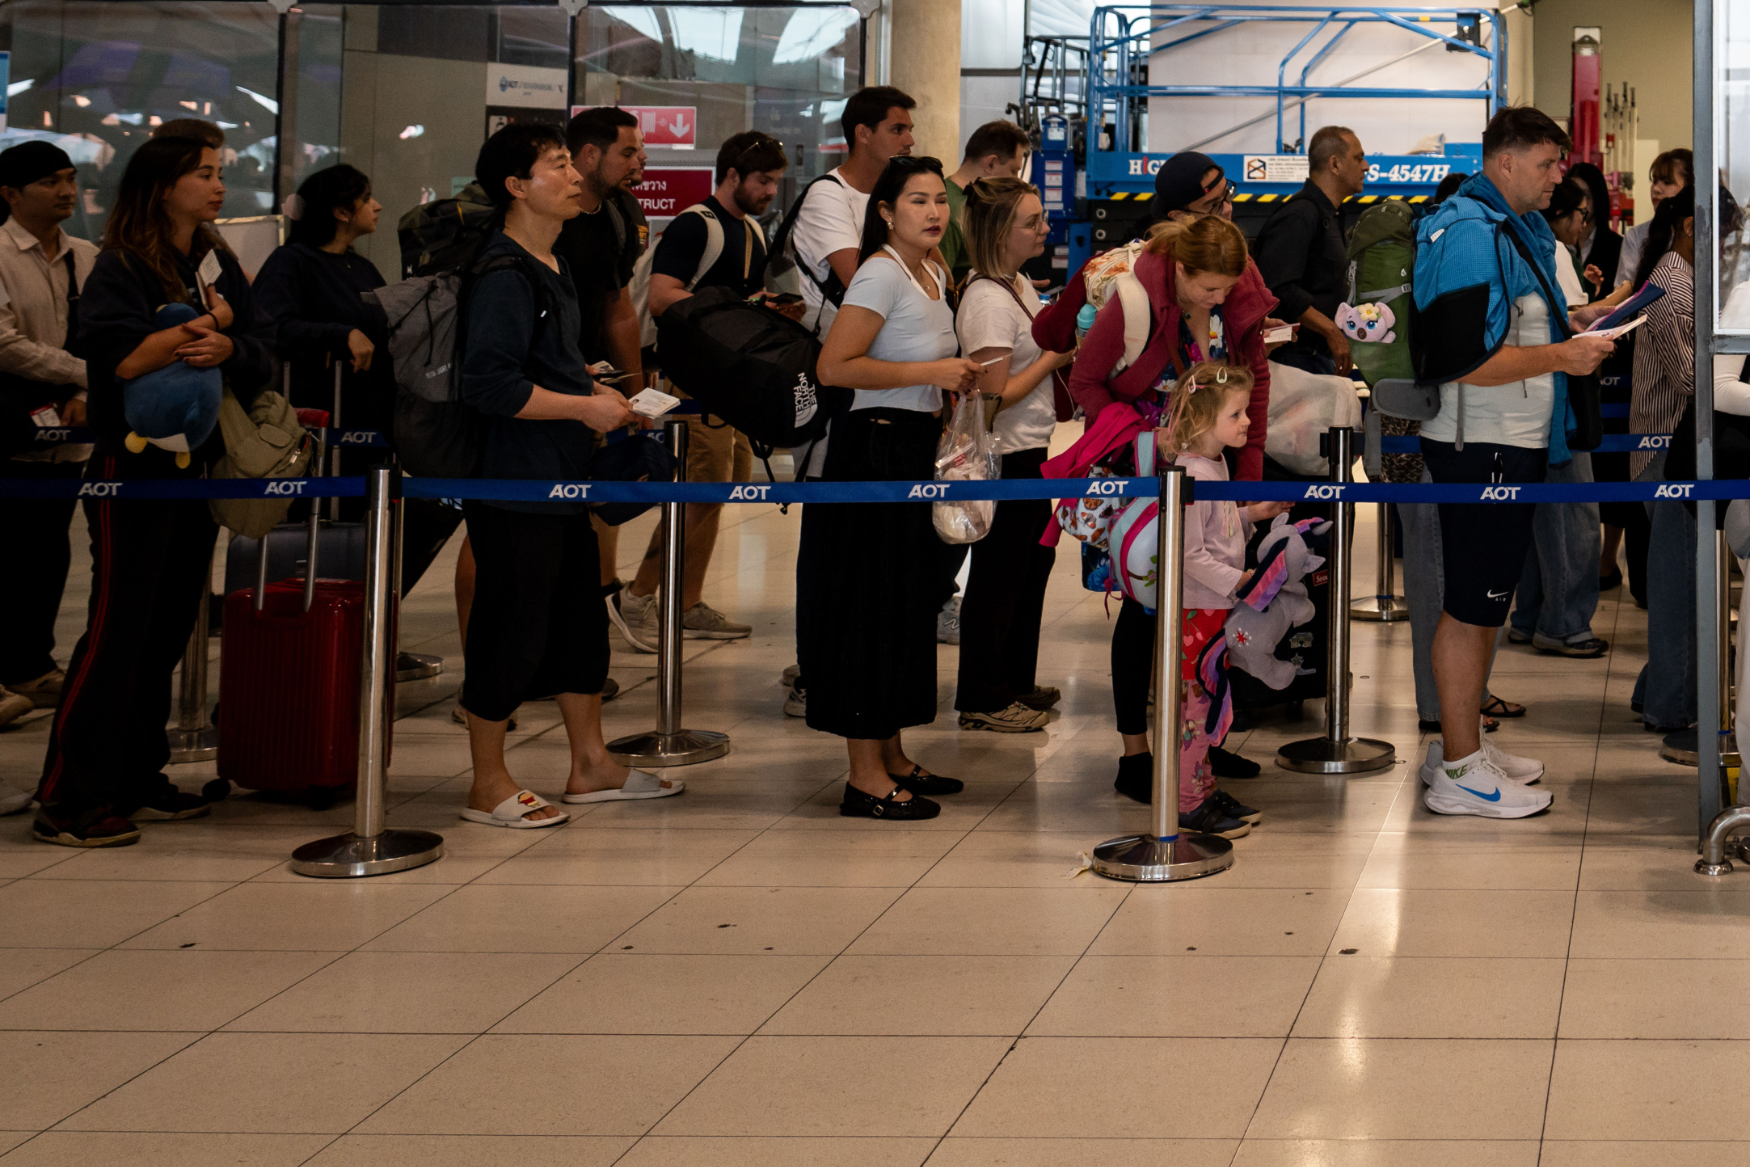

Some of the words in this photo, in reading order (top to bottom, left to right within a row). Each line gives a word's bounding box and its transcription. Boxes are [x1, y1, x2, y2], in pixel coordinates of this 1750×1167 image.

[1364, 164, 1451, 182] S-4547H
[637, 198, 676, 210] TRUCT
[797, 372, 811, 409] NORTH
[809, 383, 817, 405] THE
[793, 385, 804, 412] FACE
[34, 429, 72, 442] AOT
[340, 431, 377, 444] AOT
[1638, 435, 1674, 449] AOT
[77, 482, 123, 496] AOT
[264, 481, 307, 495] AOT
[548, 484, 592, 499] AOT
[728, 485, 772, 500] AOT
[907, 483, 951, 499] AOT
[1085, 480, 1129, 495] AOT
[1303, 485, 1346, 500] AOT
[1479, 486, 1522, 501] AOT
[1654, 484, 1695, 498] AOT
